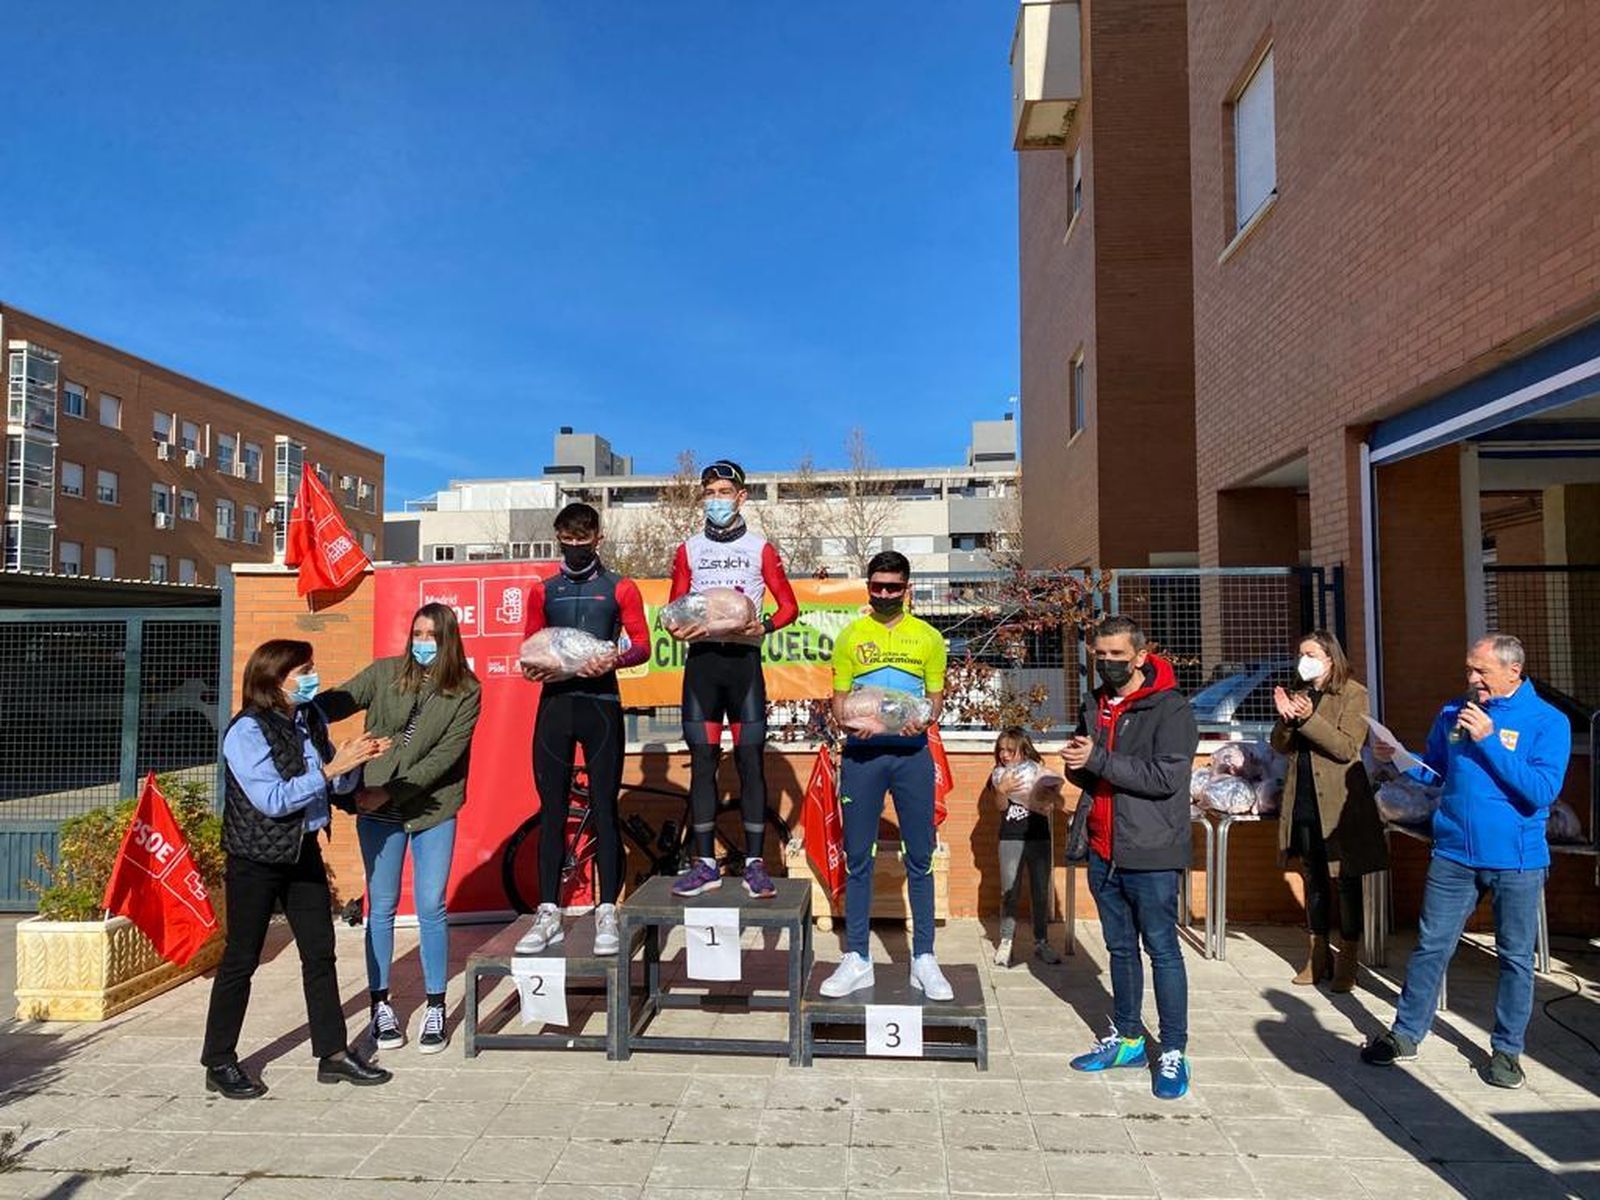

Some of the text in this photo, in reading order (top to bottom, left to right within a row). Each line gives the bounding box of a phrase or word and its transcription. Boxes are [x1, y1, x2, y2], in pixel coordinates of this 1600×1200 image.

[425, 594, 457, 605] Madrid
[705, 926, 720, 946] 1
[531, 975, 545, 997] 2
[885, 1022, 902, 1048] 3
